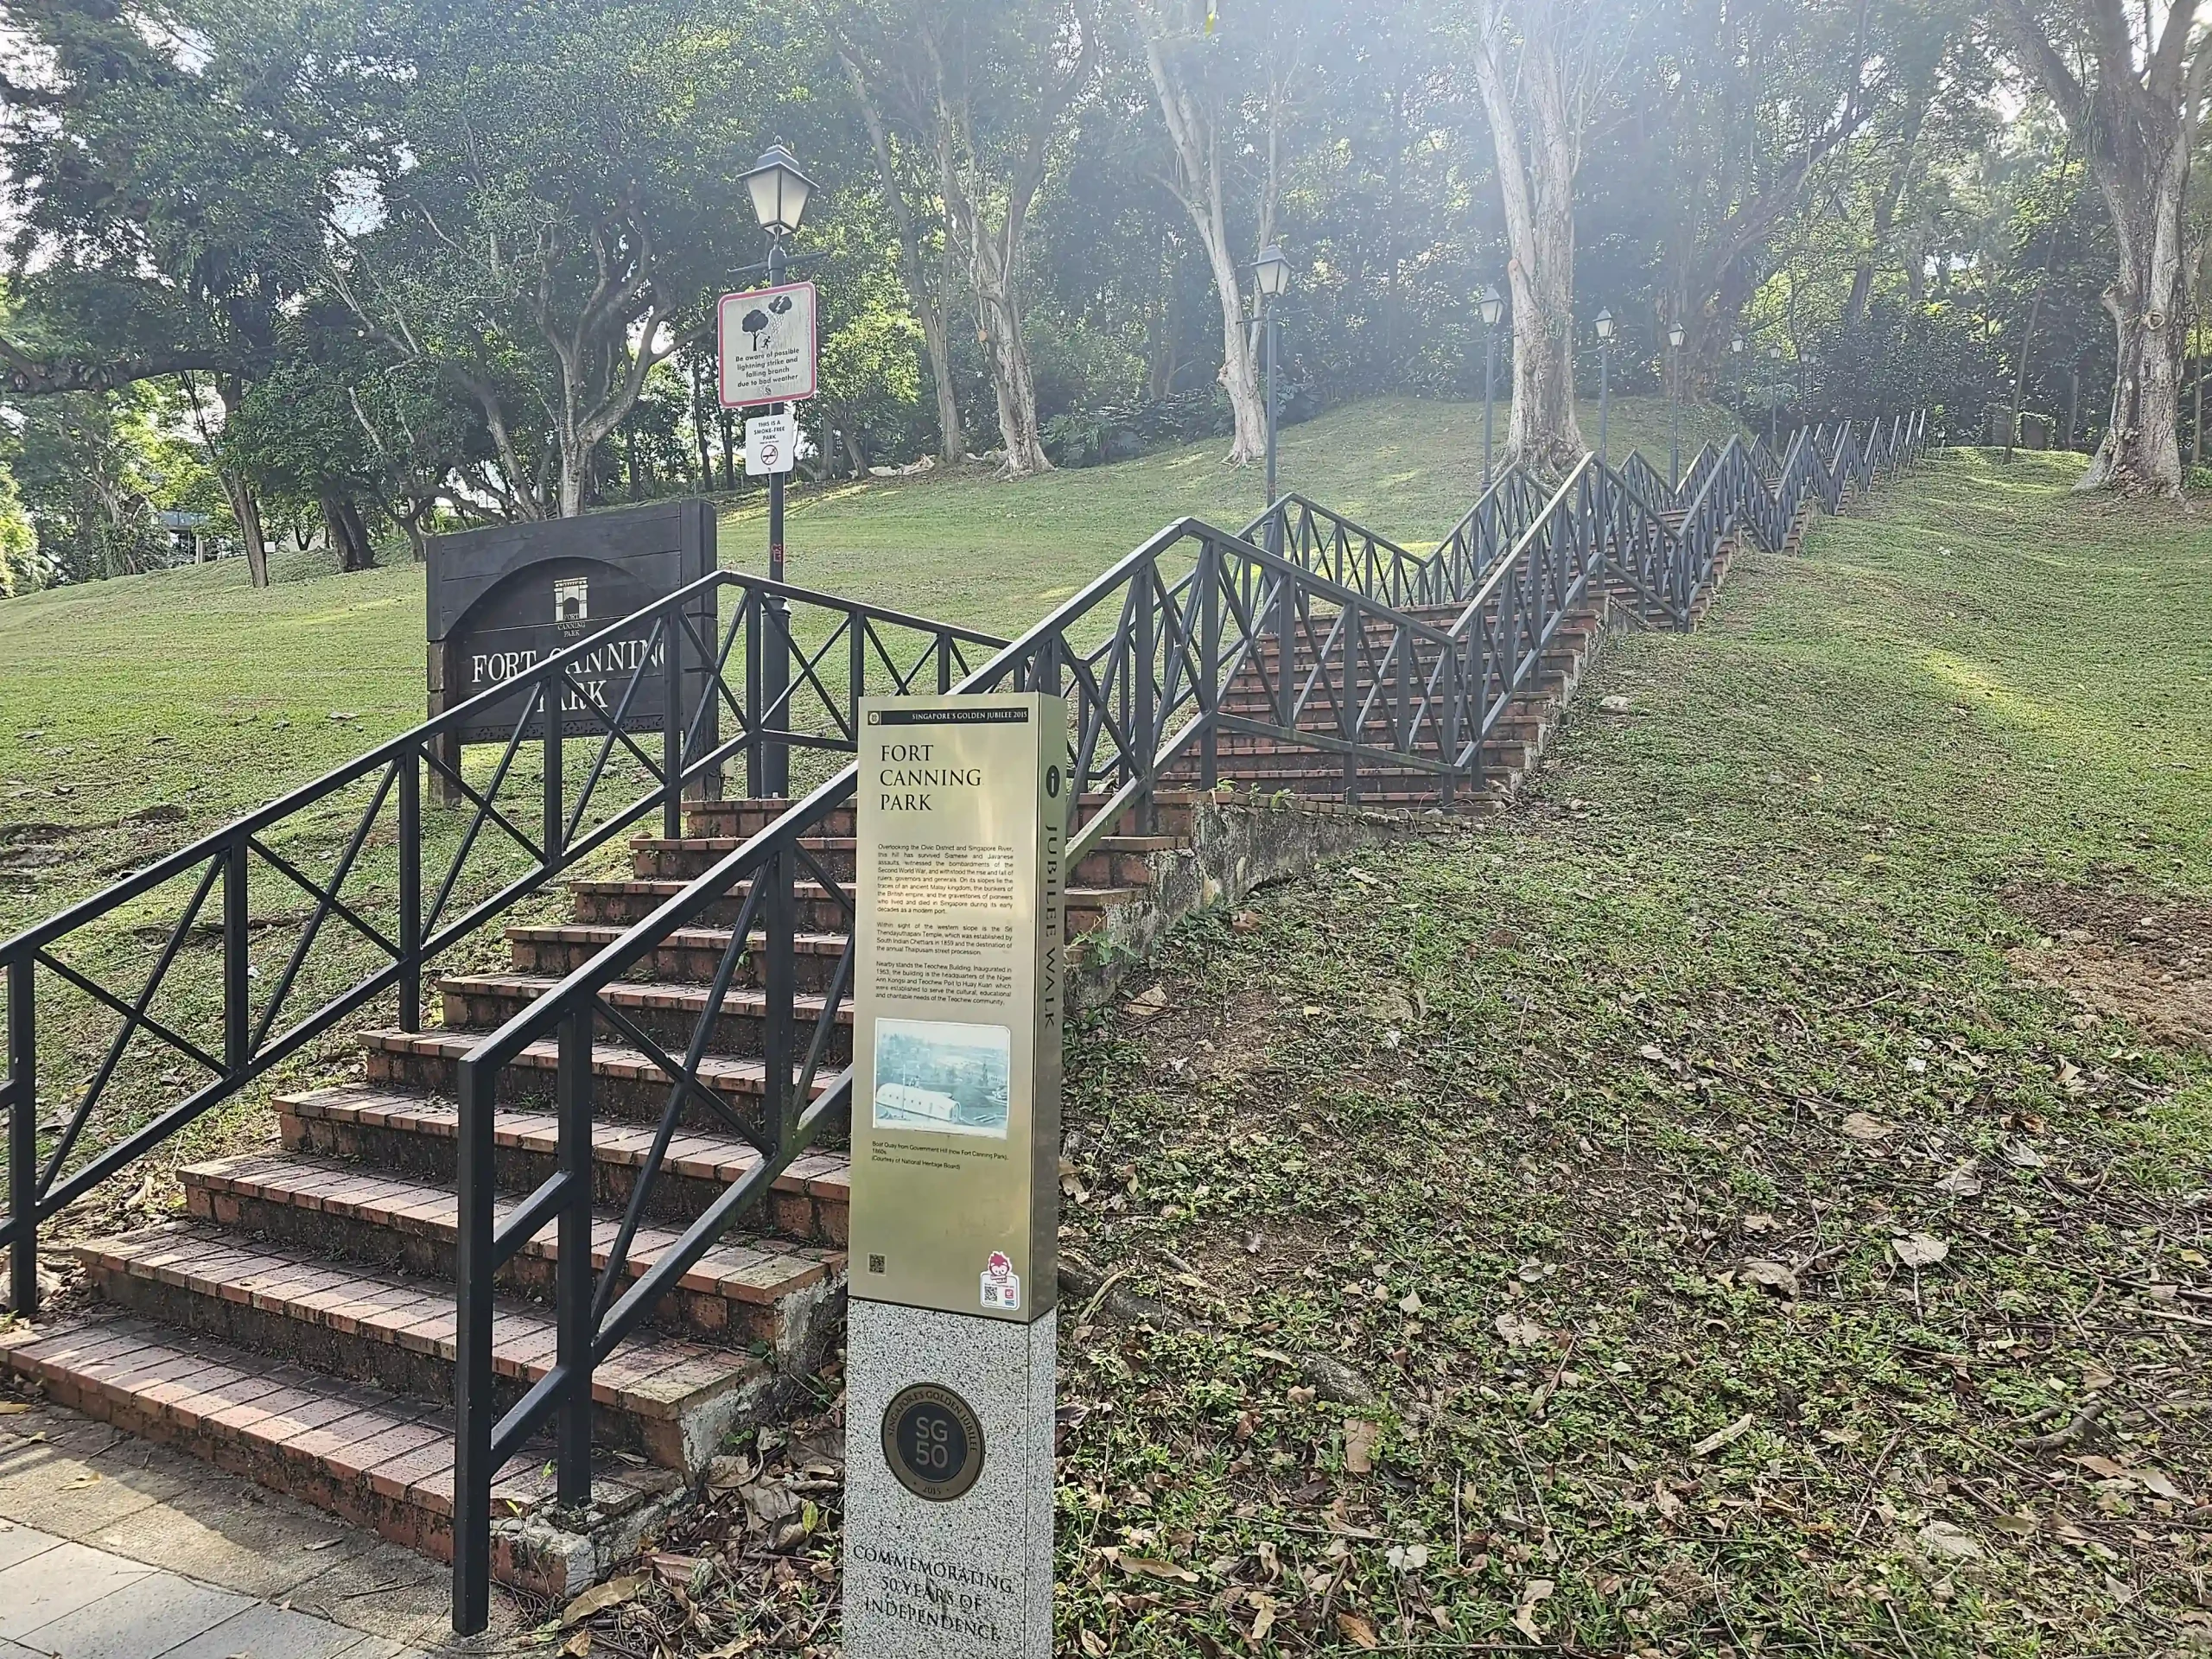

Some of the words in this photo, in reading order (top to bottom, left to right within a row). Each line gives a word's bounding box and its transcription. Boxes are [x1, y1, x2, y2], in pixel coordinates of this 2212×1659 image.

[774, 347, 799, 358] possible
[737, 362, 766, 372] lightning
[766, 359, 785, 367] strike
[746, 370, 766, 378] falling
[767, 366, 790, 375] branch
[772, 374, 798, 383] weather
[753, 426, 785, 435] SMOKE-FREE
[557, 621, 586, 631] CANNING
[472, 650, 537, 683] FORT
[987, 711, 1013, 720] JUBILEE
[880, 744, 934, 761] FORT
[880, 768, 981, 786] CANNING
[880, 794, 933, 810] PARK
[878, 843, 909, 852] Overlooking
[969, 844, 995, 853] Singapore
[915, 867, 927, 875] War,
[1046, 825, 1057, 937] JUBILEE
[931, 883, 946, 892] Malay
[940, 899, 968, 907] Singapore
[970, 899, 988, 908] during
[1000, 900, 1013, 909] early
[876, 960, 895, 969] Nearby
[903, 969, 924, 978] building
[1045, 947, 1056, 1028] WALK
[926, 1390, 963, 1414] GOLDEN
[960, 1414, 977, 1452] JUBILEE
[916, 1416, 948, 1442] SG
[916, 1441, 949, 1469] 50
[923, 1486, 942, 1495] 2015
[853, 1544, 1012, 1593] COMMEMORATING
[881, 1575, 899, 1592] 50
[900, 1579, 954, 1605] YEARS
[960, 1594, 982, 1611] OF
[864, 1596, 1001, 1641] INDEPENDENCE
